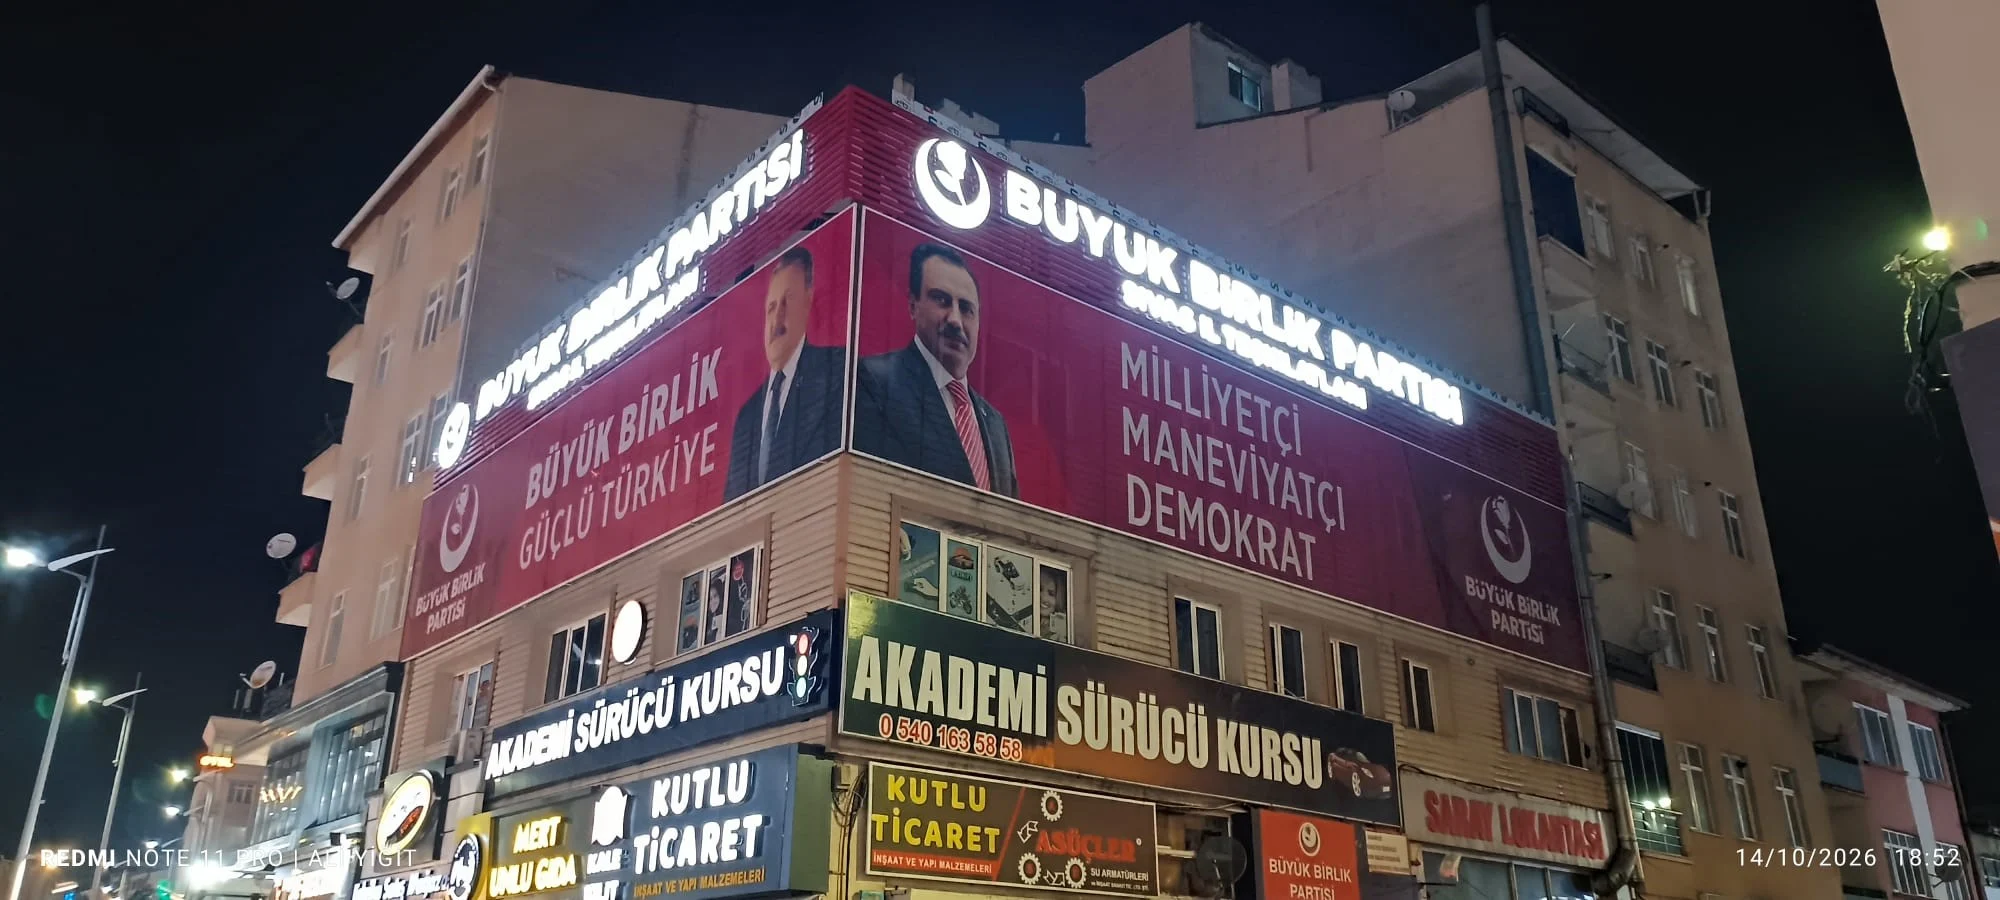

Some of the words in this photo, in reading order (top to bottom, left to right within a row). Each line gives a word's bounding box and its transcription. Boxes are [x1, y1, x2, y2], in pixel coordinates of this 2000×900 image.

[1121, 342, 1302, 456] MİLLİYETÇİ
[526, 415, 616, 510] BÜYÜK
[618, 347, 723, 455] BİRLİK
[1122, 407, 1345, 533] MANEVİYATÇI
[519, 488, 594, 571] GÜÇLÜ
[598, 423, 719, 529] TÜRKİYE
[1127, 473, 1316, 581] DEMOKRAT
[1465, 575, 1515, 611] BÜYÜK
[1491, 609, 1544, 645] PARTİSİ
[485, 709, 574, 781] AKADEMİ
[574, 676, 677, 753] SÜRÜCÜ
[680, 646, 785, 722] KURSU
[852, 635, 1048, 737] AKADEMİ
[1057, 680, 1209, 769] SÜRÜCÜ
[1216, 718, 1323, 789] KURSU
[879, 713, 893, 738] 0
[896, 716, 933, 745] 540
[936, 724, 970, 752] 163
[974, 731, 997, 759] 58
[1000, 737, 1022, 762] 58
[651, 760, 751, 818] KUTLU
[887, 774, 987, 812] KUTLU
[513, 816, 562, 854] MERT
[633, 814, 763, 875] TİCARET
[871, 807, 1000, 854] TİCARET
[490, 861, 534, 897] UNLU
[535, 854, 577, 890] GIDA
[587, 848, 622, 875] KALE
[665, 882, 677, 893] VE
[680, 877, 697, 892] YAPI
[700, 864, 765, 889] MALZEMELERİ
[873, 852, 903, 866] İNŞAAT
[906, 857, 916, 866] VE
[918, 858, 937, 868] YAPI
[939, 861, 992, 873] MALZEMELERİ
[1091, 868, 1101, 877] SU
[1101, 869, 1149, 881] ARMATÜRLERİ
[1269, 856, 1311, 878] BÜYÜK
